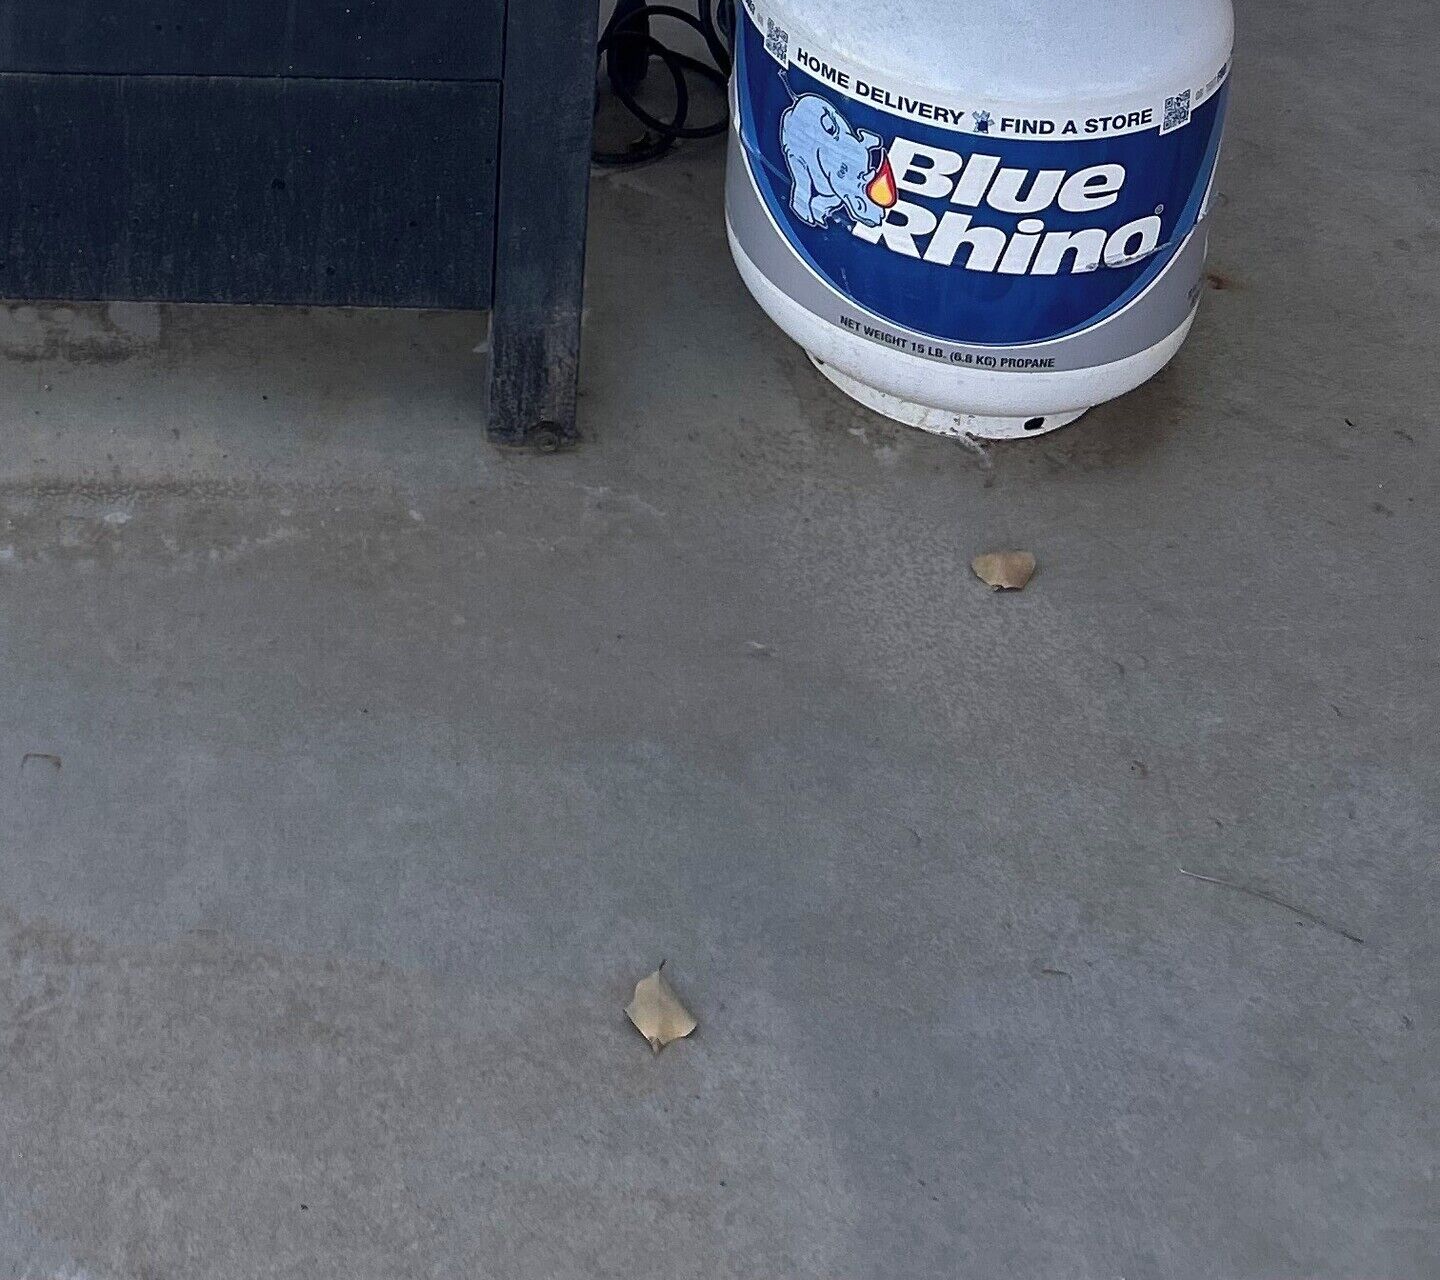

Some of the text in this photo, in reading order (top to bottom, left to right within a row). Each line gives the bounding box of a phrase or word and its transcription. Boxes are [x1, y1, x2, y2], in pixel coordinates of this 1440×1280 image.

[797, 47, 965, 126] HOME DELIVERY
[1000, 108, 1153, 135] FIND A STORE
[887, 136, 1126, 214] Blue
[851, 200, 1161, 276] Rhino
[839, 315, 861, 332] NET
[863, 325, 908, 349] WEIGHT
[911, 342, 925, 354] 15
[976, 356, 997, 368] KG)
[1000, 357, 1056, 369] PROPANE
